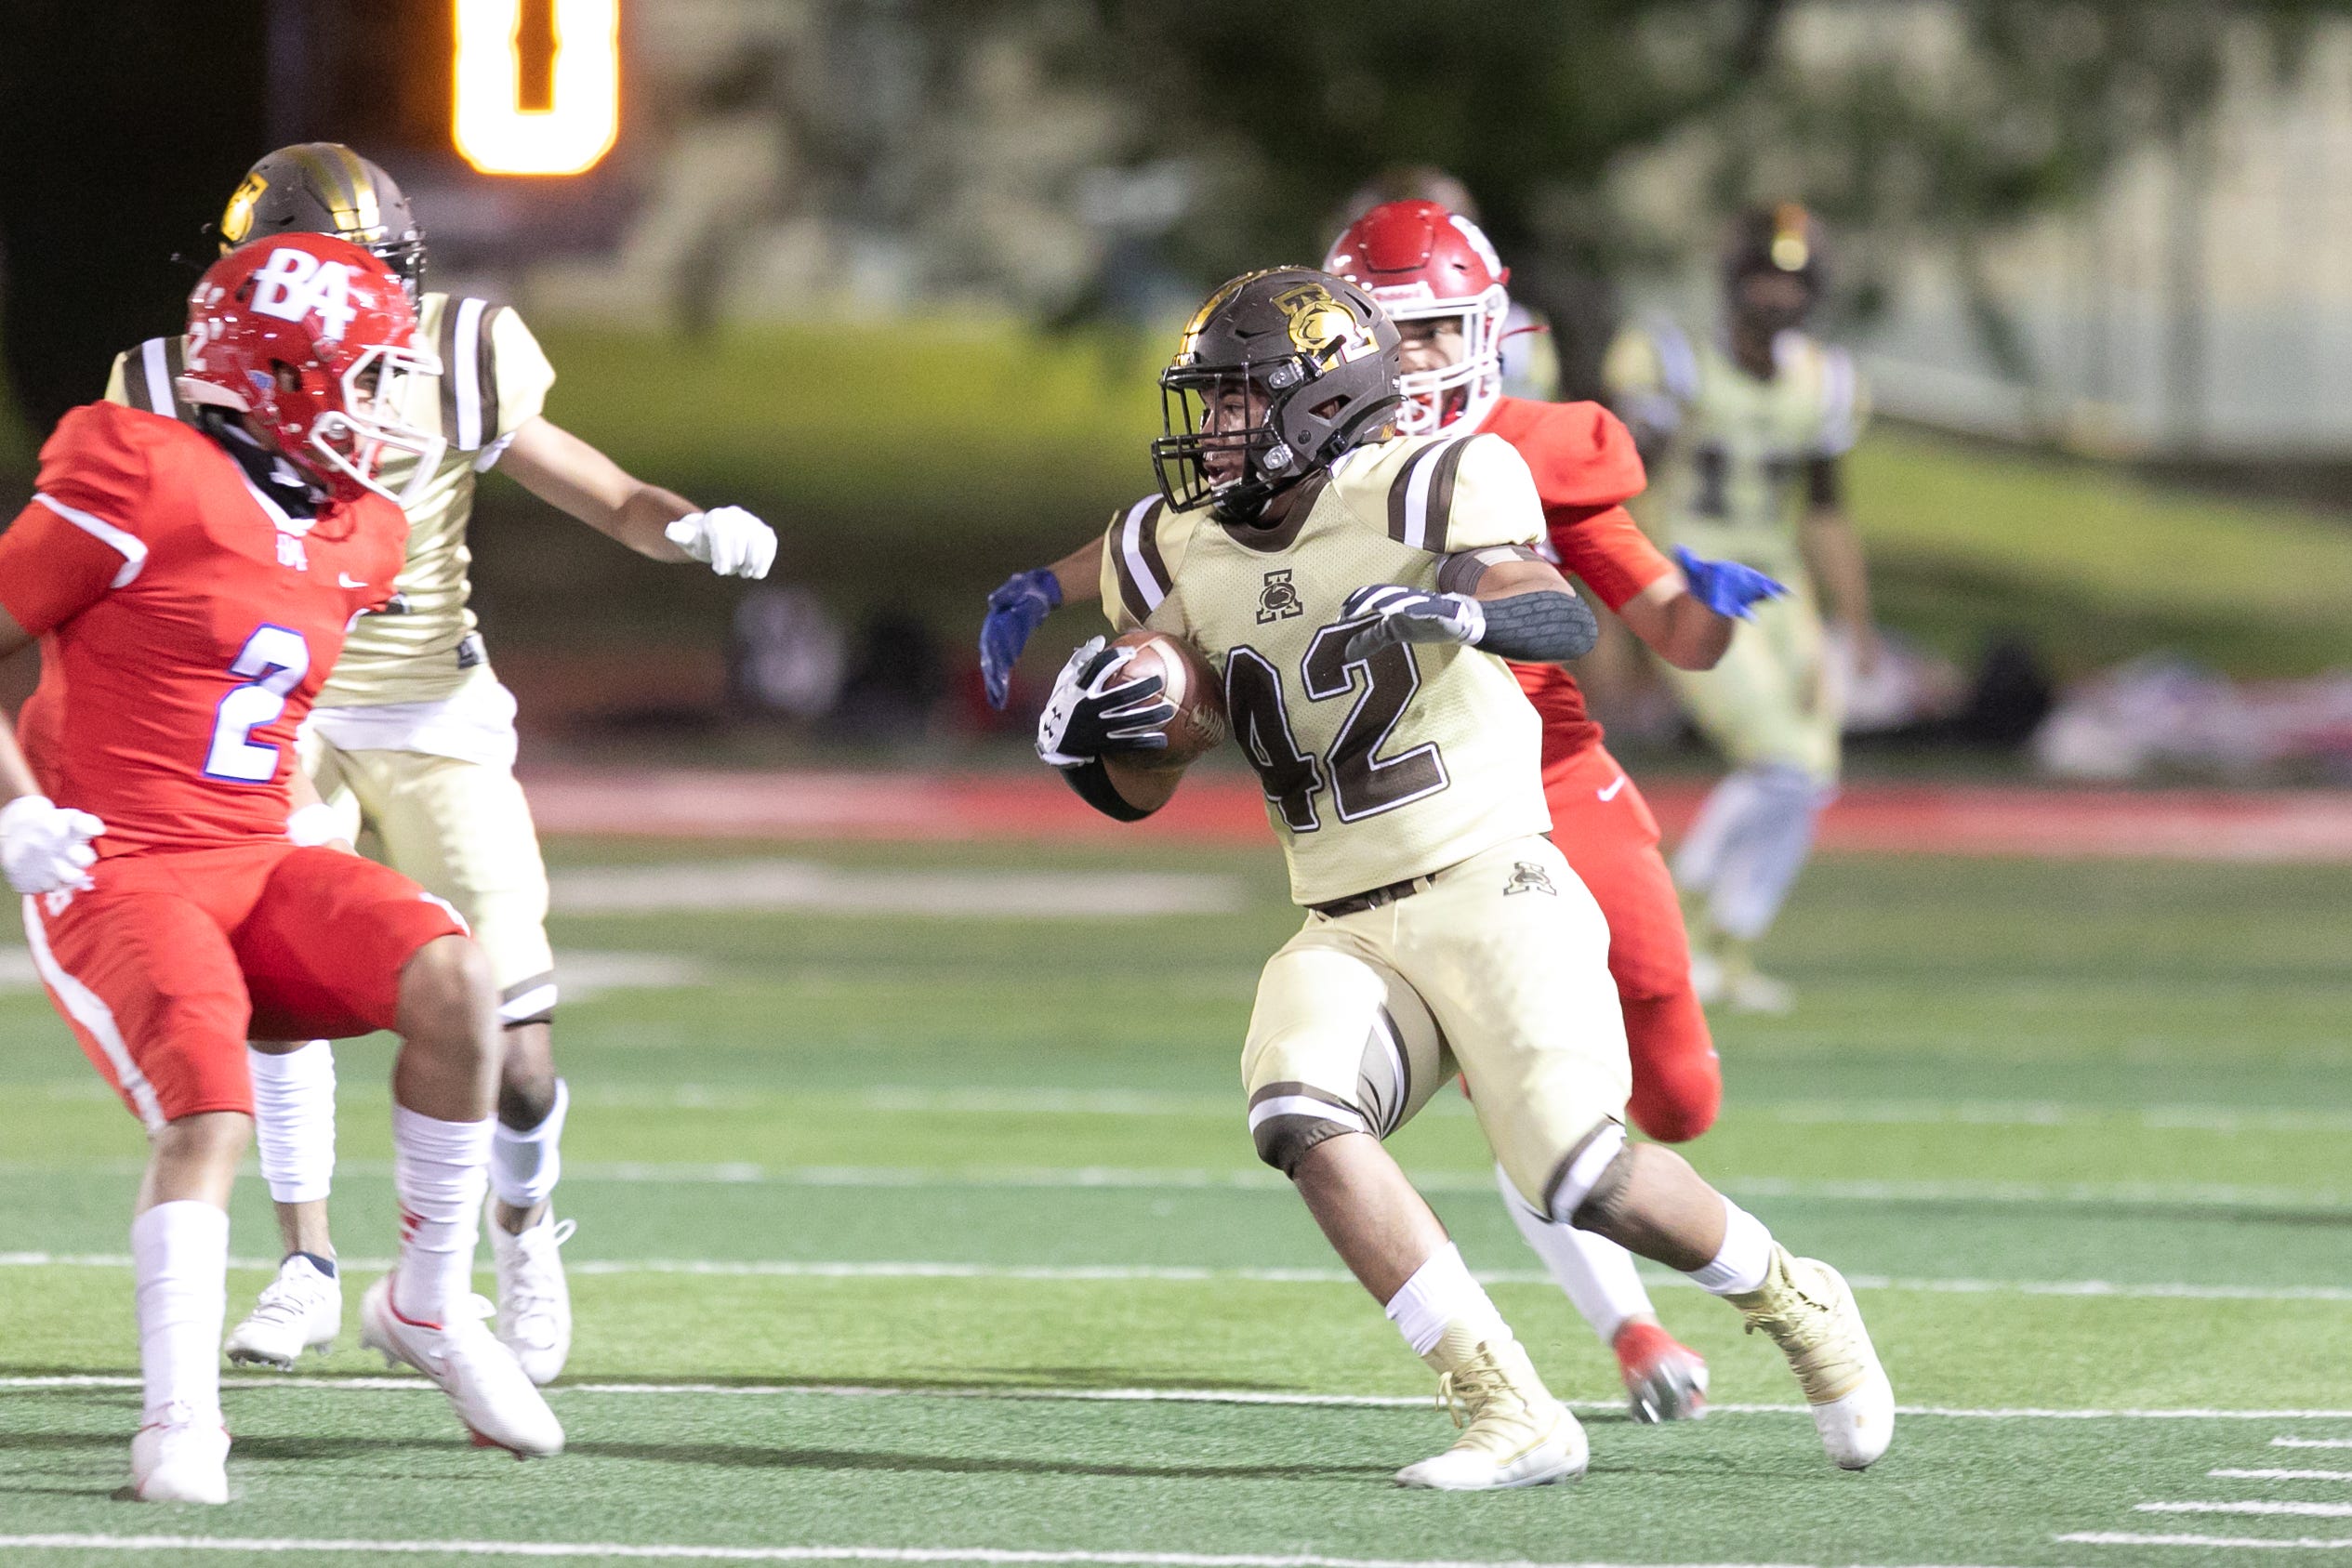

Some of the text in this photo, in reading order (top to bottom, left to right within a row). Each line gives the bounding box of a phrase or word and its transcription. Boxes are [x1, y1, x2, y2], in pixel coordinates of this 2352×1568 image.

[249, 246, 358, 342] BA
[201, 622, 311, 784] 2
[1225, 613, 1450, 834] 42
